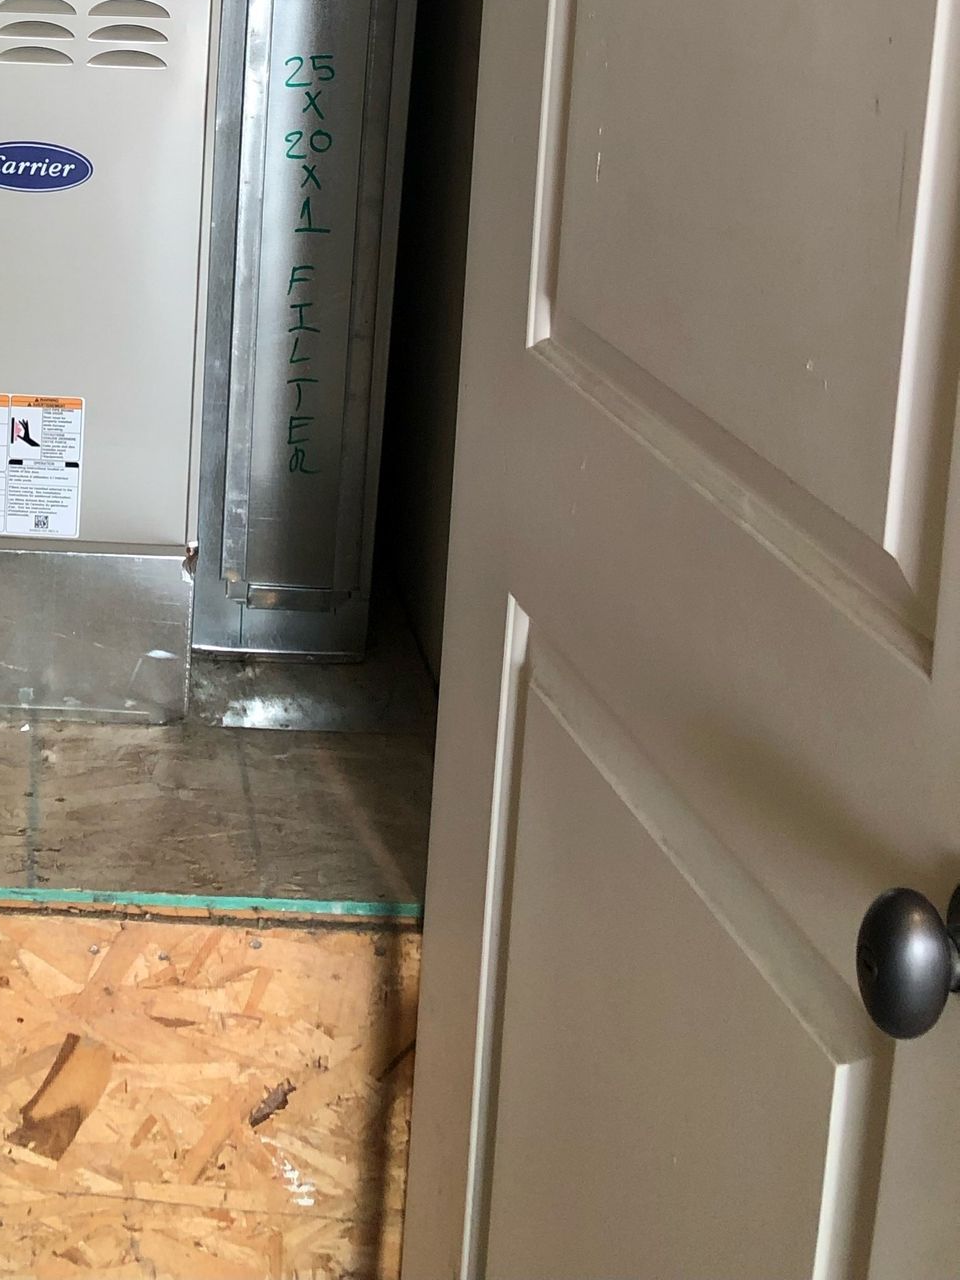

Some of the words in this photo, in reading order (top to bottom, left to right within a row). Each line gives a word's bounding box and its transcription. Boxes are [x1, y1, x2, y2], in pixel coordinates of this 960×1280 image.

[285, 55, 335, 88] 25
[285, 130, 332, 160] 20
[294, 197, 331, 233] 1
